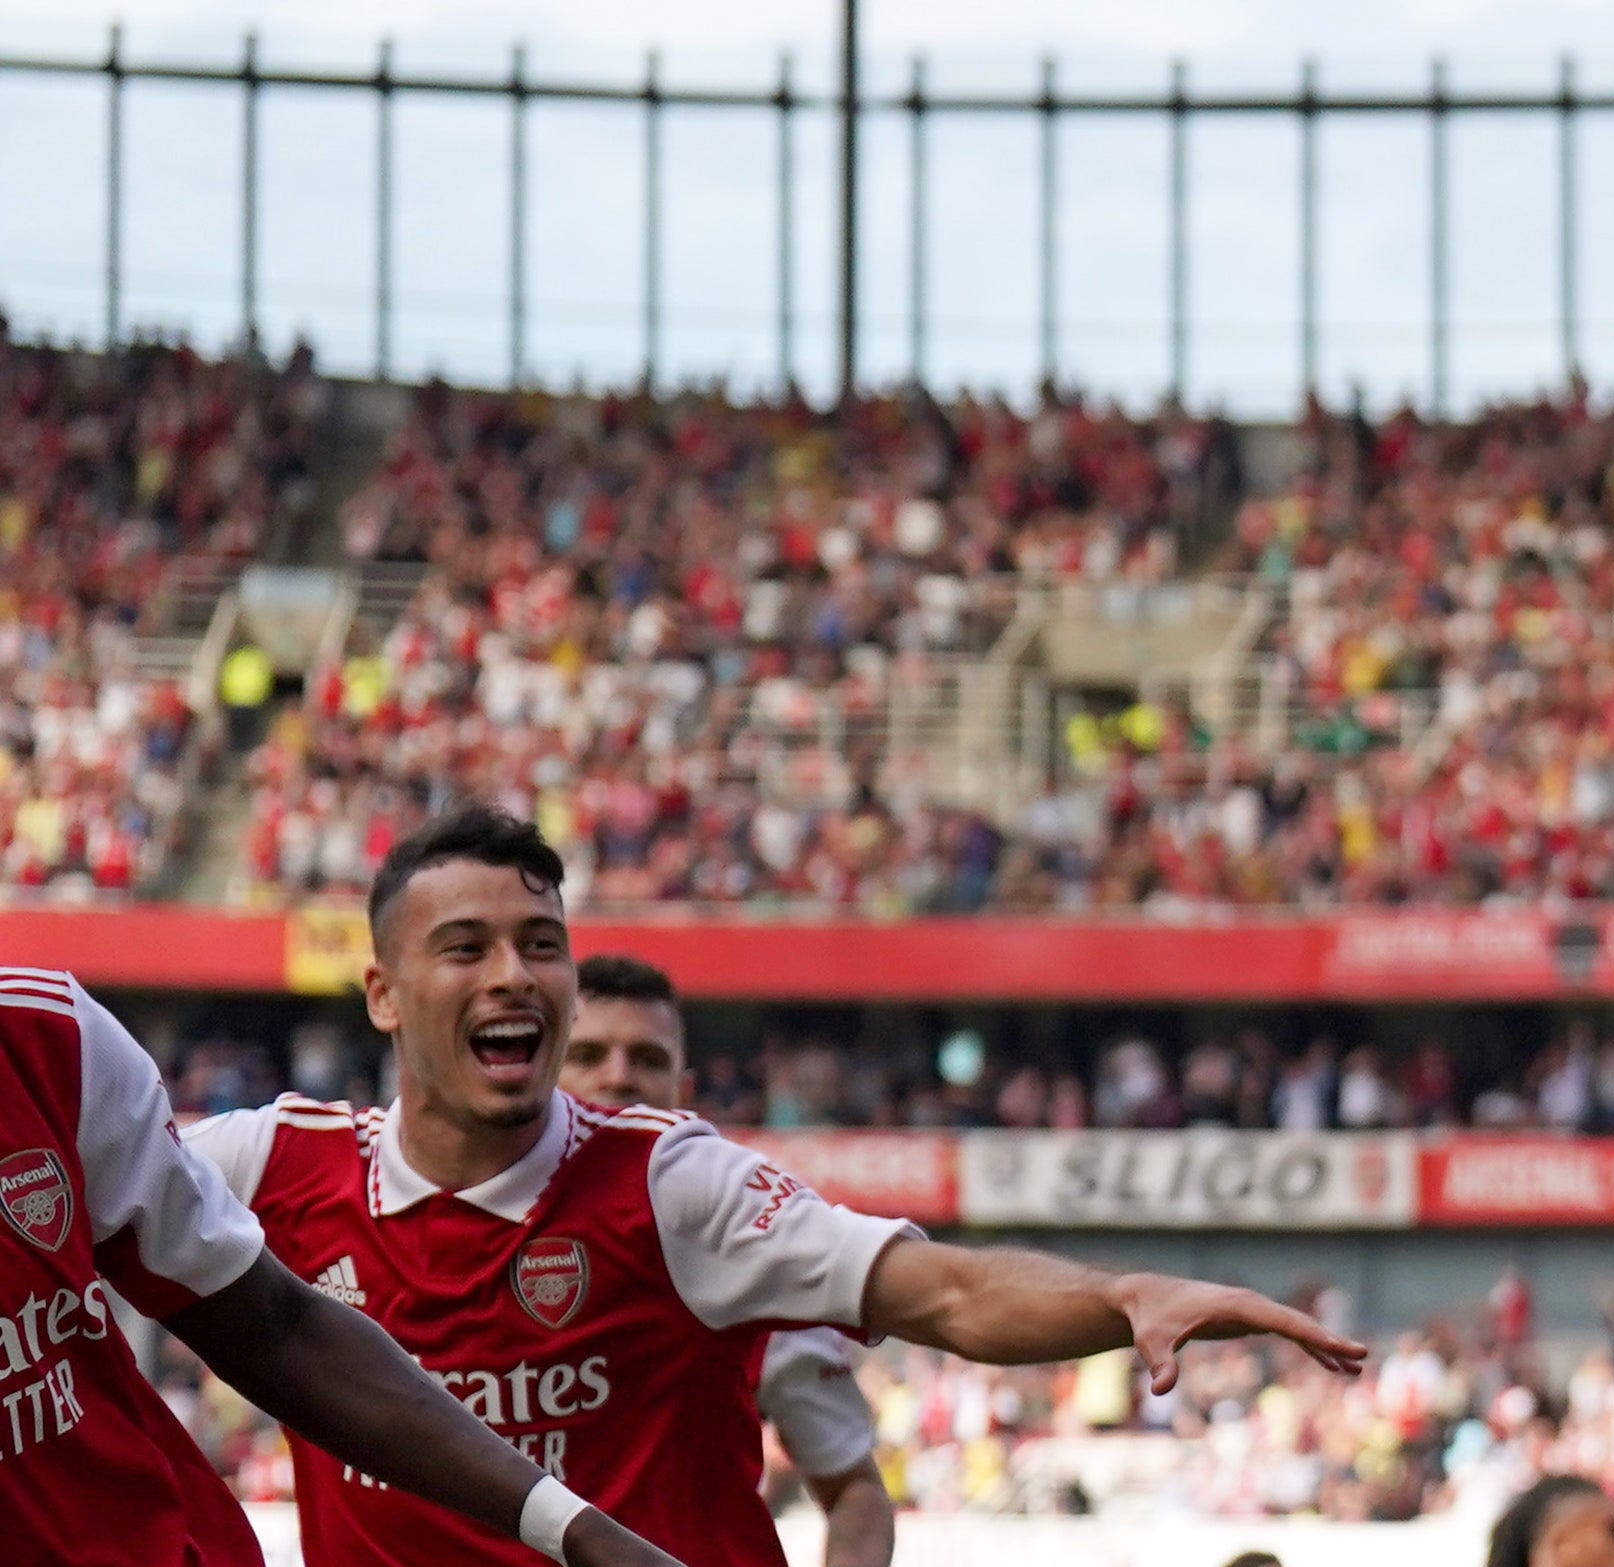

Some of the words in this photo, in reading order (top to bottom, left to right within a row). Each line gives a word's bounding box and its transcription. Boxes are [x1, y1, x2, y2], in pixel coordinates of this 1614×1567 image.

[1, 1161, 54, 1192] Arsenal
[1062, 1144, 1326, 1203] SLIGO
[521, 1251, 580, 1269] Arsenal
[0, 1279, 107, 1379] ates
